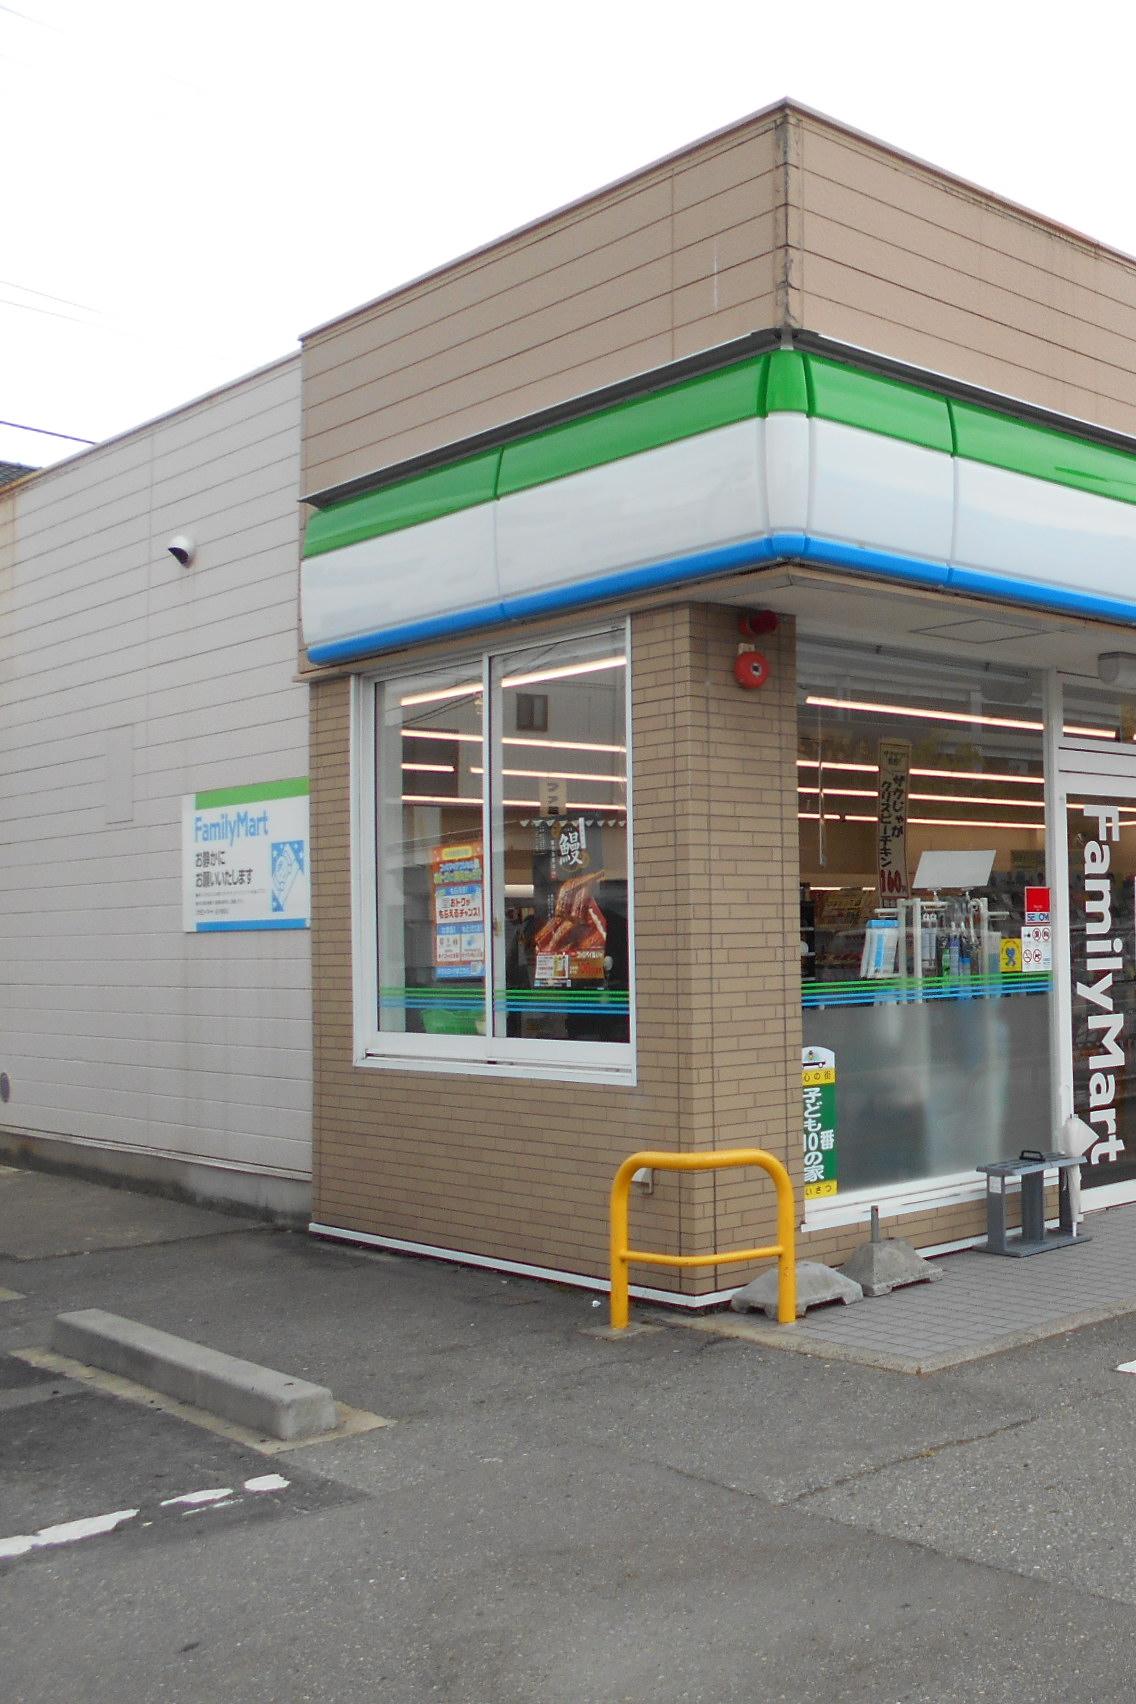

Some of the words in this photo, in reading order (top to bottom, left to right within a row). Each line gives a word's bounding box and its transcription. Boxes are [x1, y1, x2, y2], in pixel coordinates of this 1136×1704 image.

[194, 810, 269, 847] FamilyMart
[559, 831, 583, 865] 鰻
[195, 868, 253, 888] お願いいたします
[1076, 804, 1125, 1166] FamilyMart
